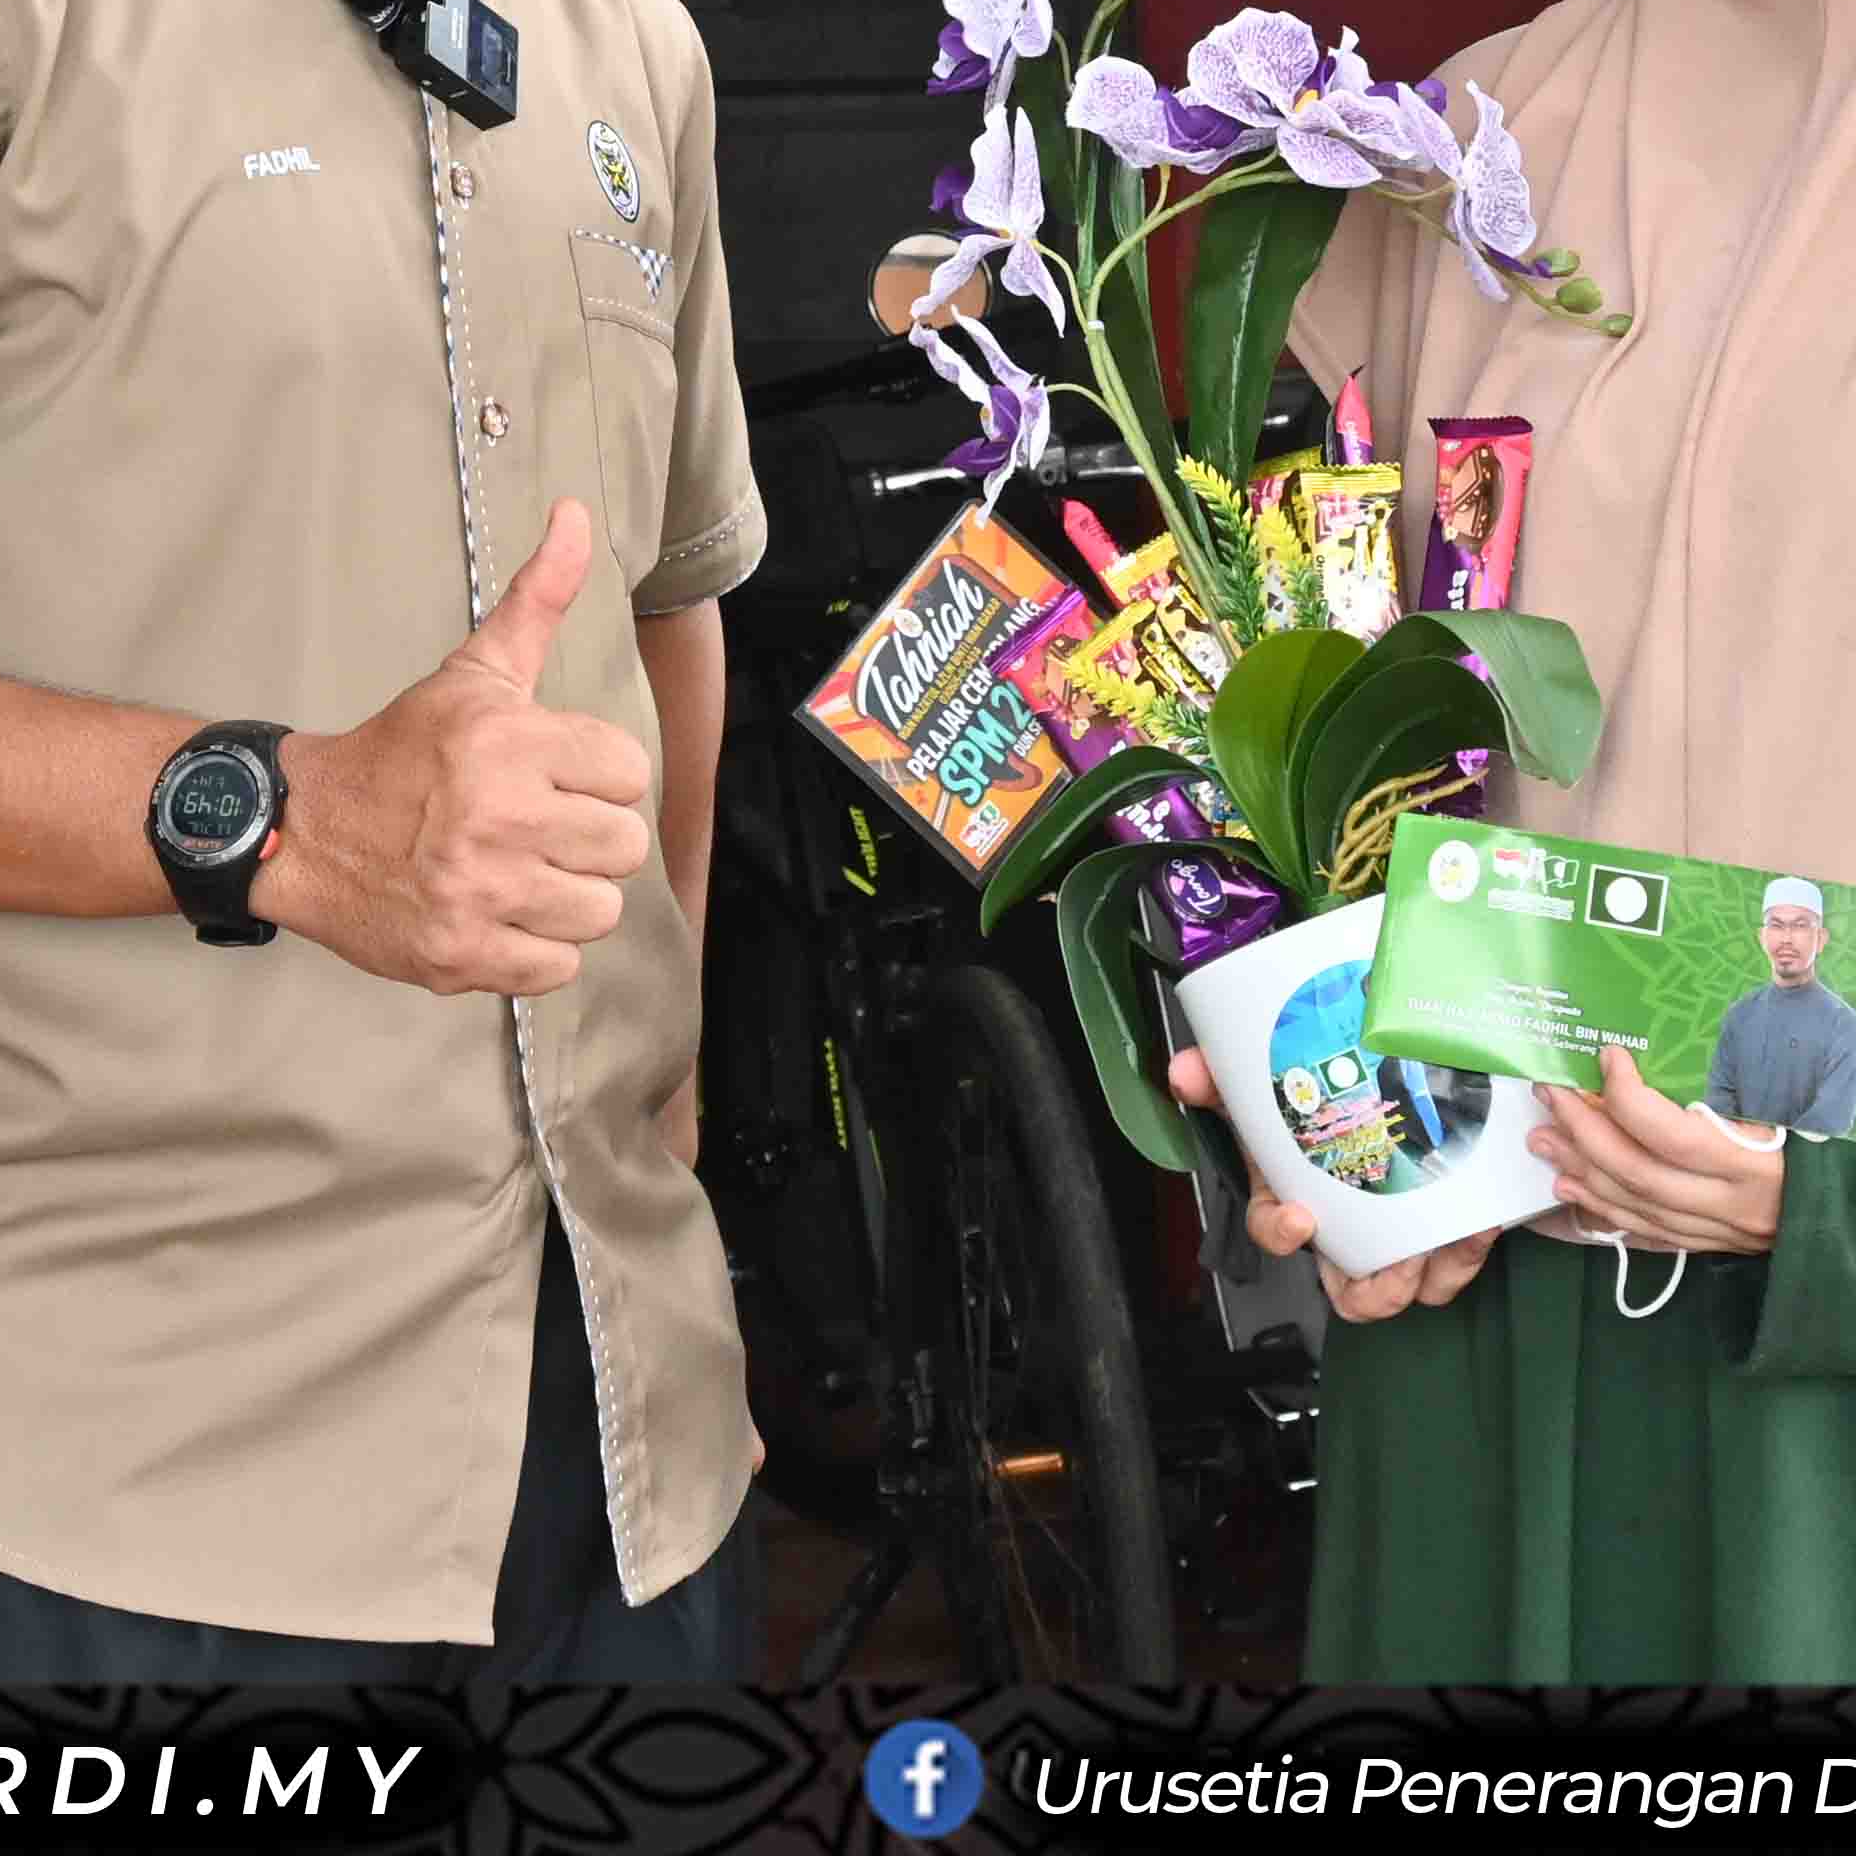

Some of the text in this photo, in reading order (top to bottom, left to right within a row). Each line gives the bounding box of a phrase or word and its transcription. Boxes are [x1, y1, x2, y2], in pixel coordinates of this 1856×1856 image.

[243, 146, 321, 178] FADHIL
[855, 558, 985, 730] Tahniah
[906, 698, 974, 782] PELAJAR
[937, 707, 1008, 806] SPM
[989, 681, 1034, 731] 2
[1012, 731, 1036, 757] DUN
[1171, 858, 1221, 915] Tango
[1575, 1025, 1599, 1041] BIN
[1600, 1030, 1649, 1051] WAHAB
